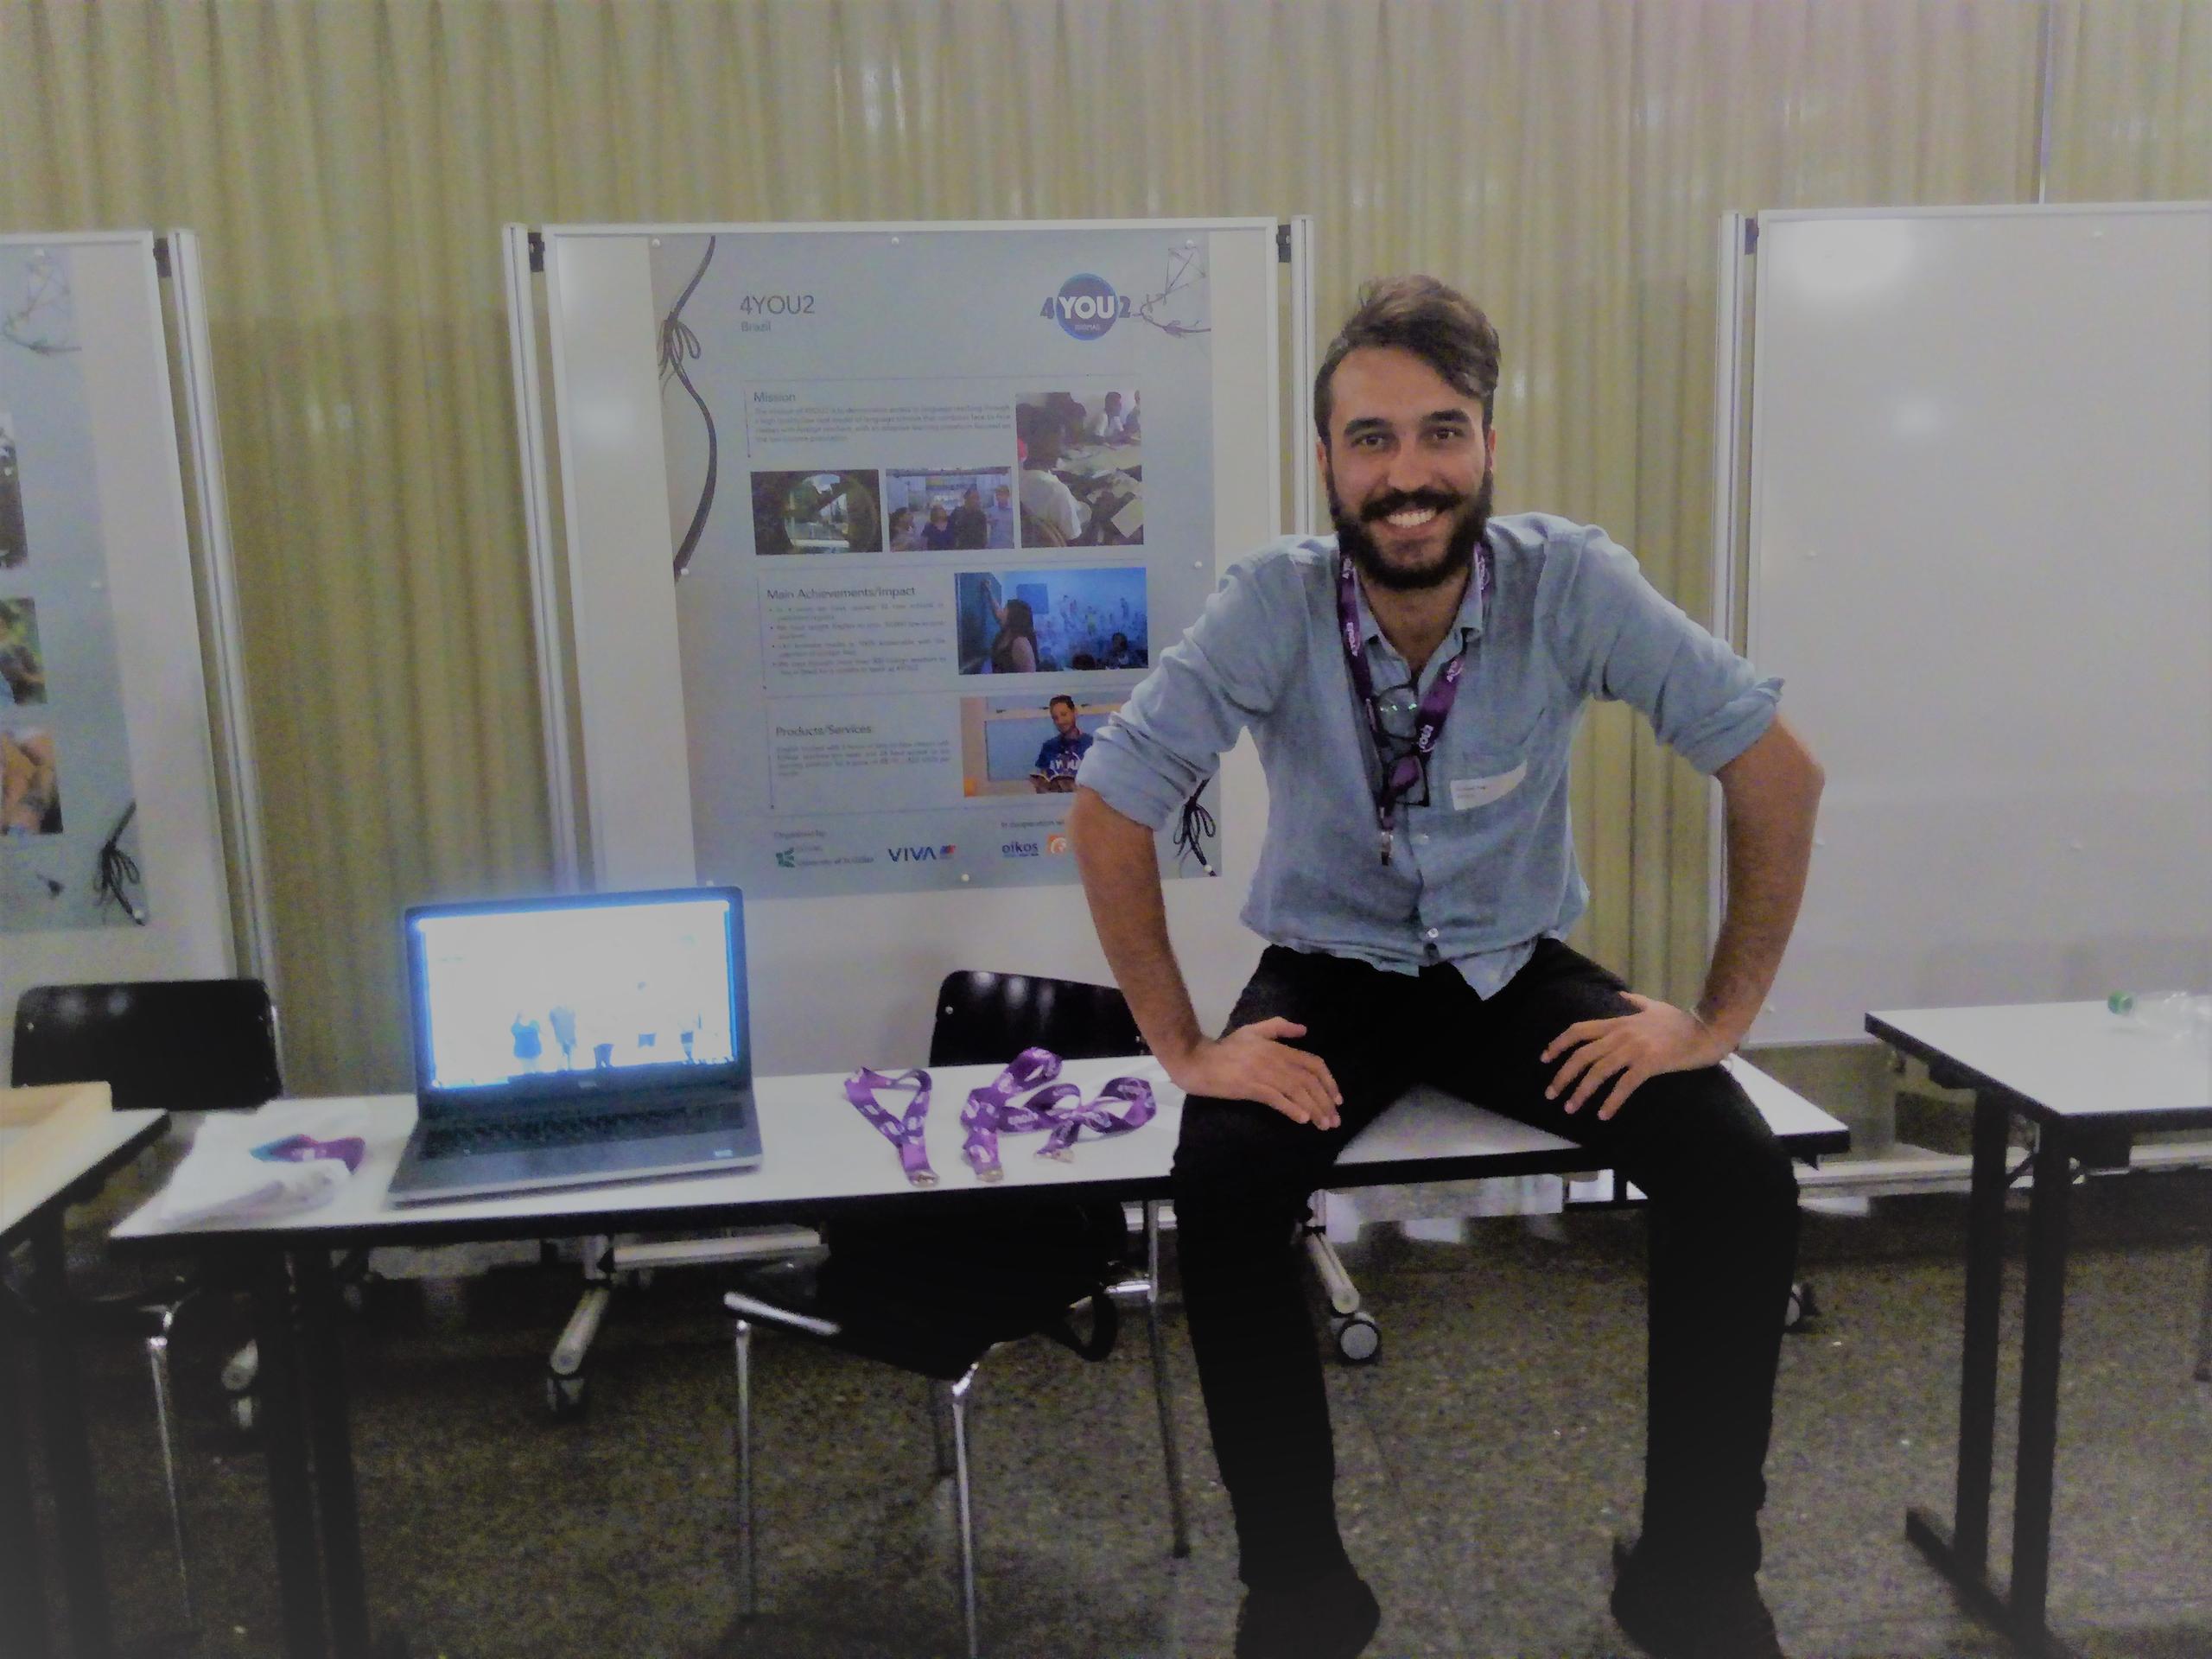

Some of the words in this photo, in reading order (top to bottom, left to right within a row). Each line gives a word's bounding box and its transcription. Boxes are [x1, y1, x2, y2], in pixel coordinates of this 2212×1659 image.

[740, 295, 815, 315] 4YOU2
[1039, 295, 1132, 320] 4YOU2
[741, 321, 771, 332] Brazil
[753, 391, 796, 403] Mission
[766, 589, 795, 600] Main
[798, 587, 916, 600] Achievements/Impact
[776, 724, 872, 736] Products/Services
[887, 845, 937, 862] VIVA
[1001, 841, 1039, 854] oikos
